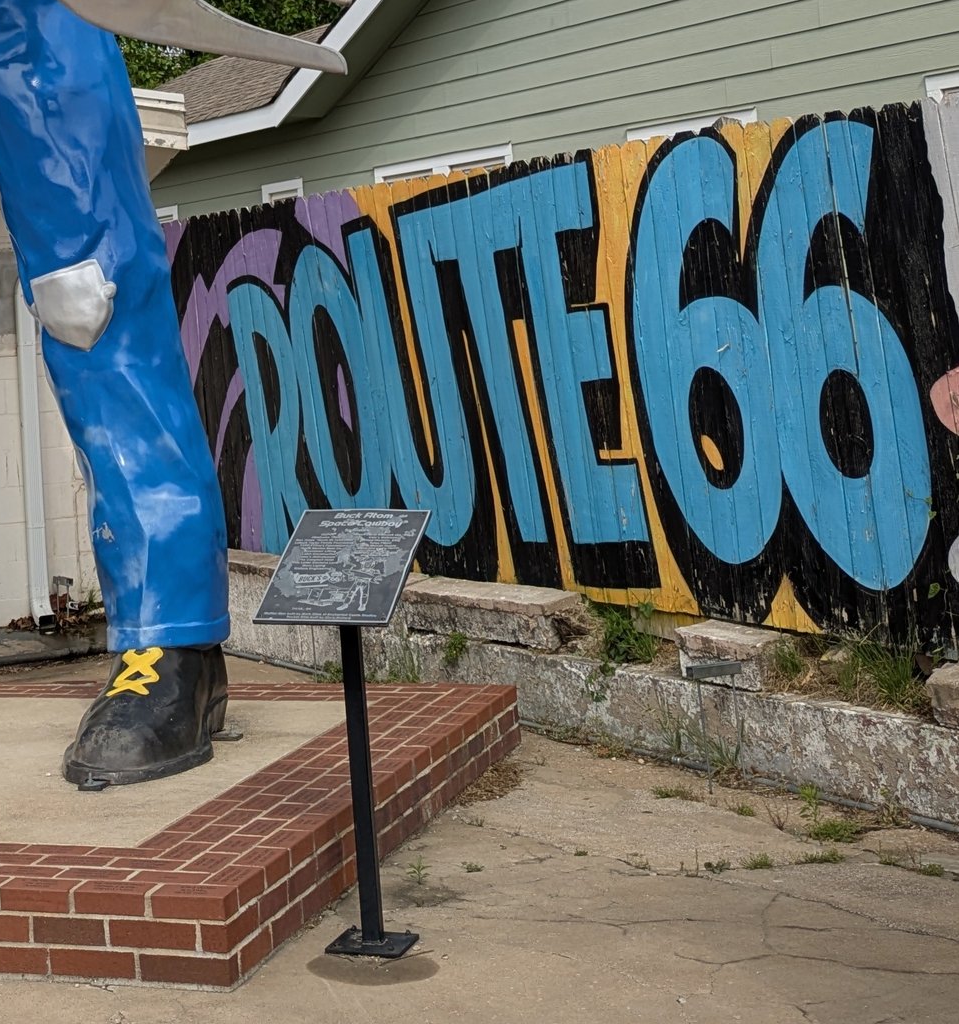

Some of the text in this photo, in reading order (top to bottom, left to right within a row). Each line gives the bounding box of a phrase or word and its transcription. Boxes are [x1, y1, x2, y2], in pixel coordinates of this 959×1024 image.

[227, 119, 931, 590] ROUTE 66
[319, 519, 403, 528] Space Cowboy
